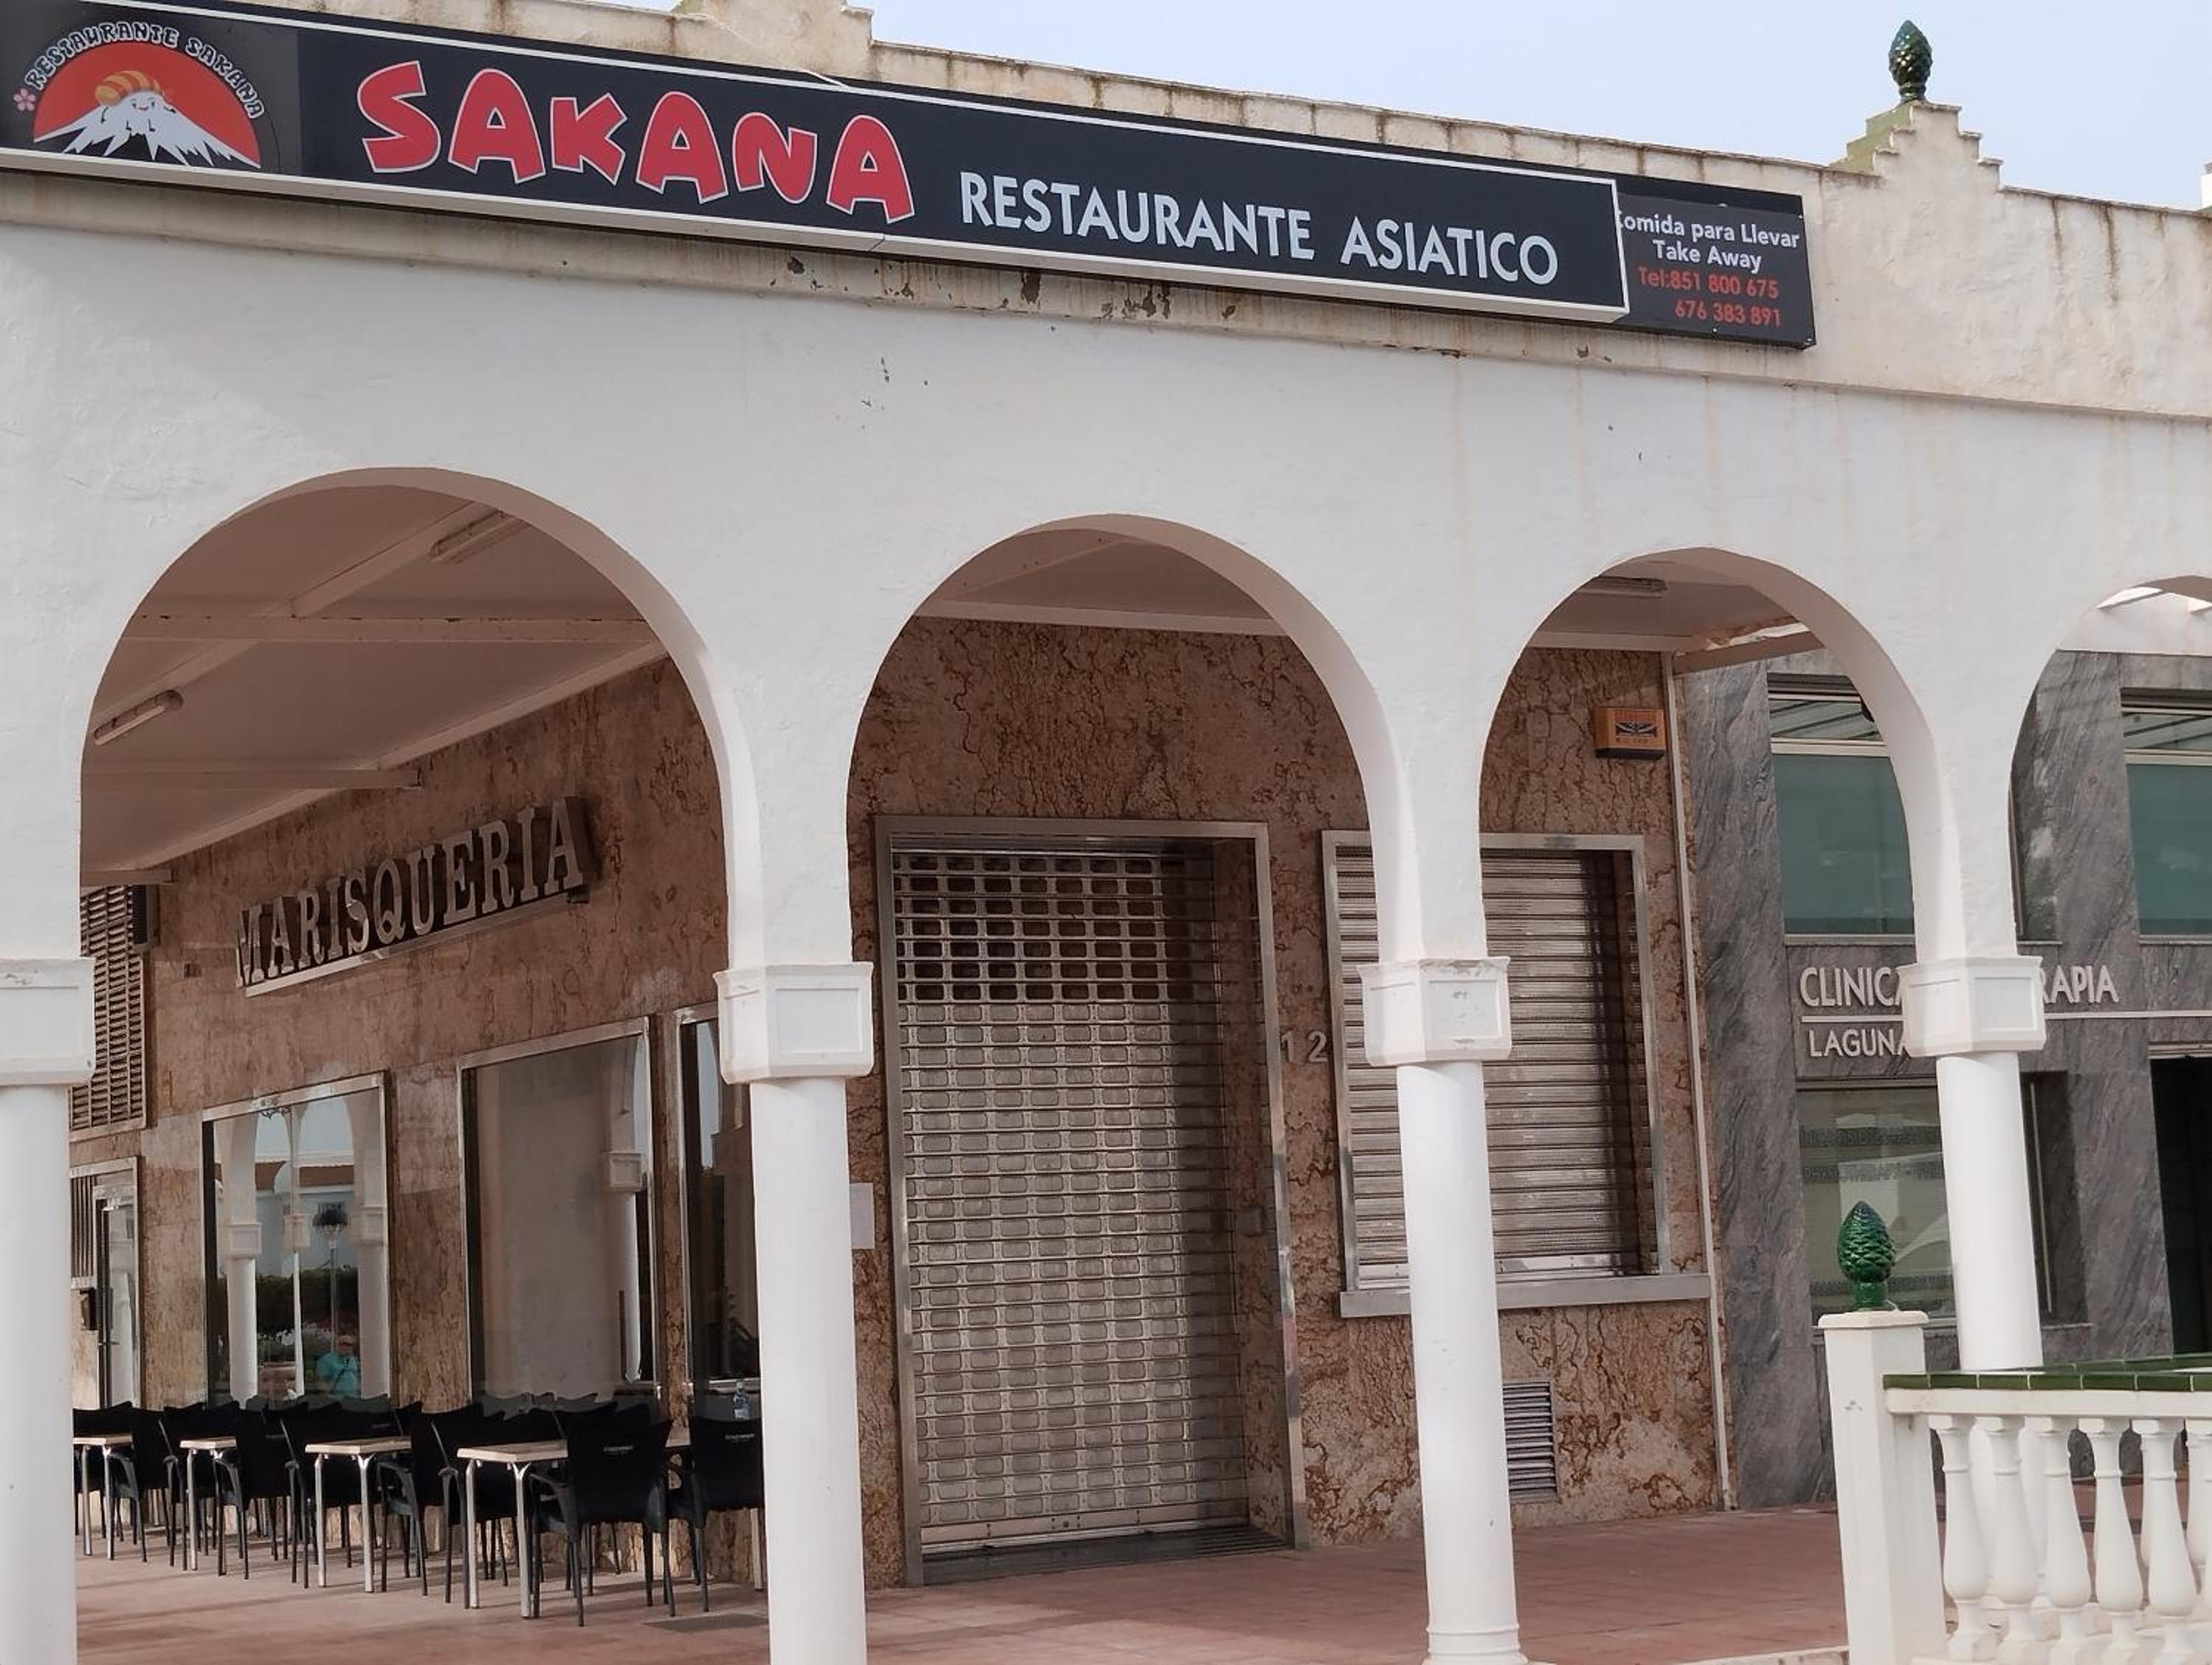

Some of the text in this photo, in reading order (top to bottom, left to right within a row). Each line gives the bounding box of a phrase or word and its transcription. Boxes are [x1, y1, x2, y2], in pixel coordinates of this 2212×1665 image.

[24, 21, 265, 119] RESTAURANTE SAKANA
[357, 60, 915, 223] SAKANA
[960, 172, 1559, 285] RESTAURANTE ASIATICO
[1619, 210, 1800, 248] omida para Llevar
[1652, 240, 1761, 274] Take Away
[1708, 274, 1740, 295] 800
[1746, 279, 1778, 299] 675
[1675, 299, 1781, 327] 676 383 891
[235, 796, 585, 988] MARISQUERIA
[1800, 967, 1901, 1007] CLINIC
